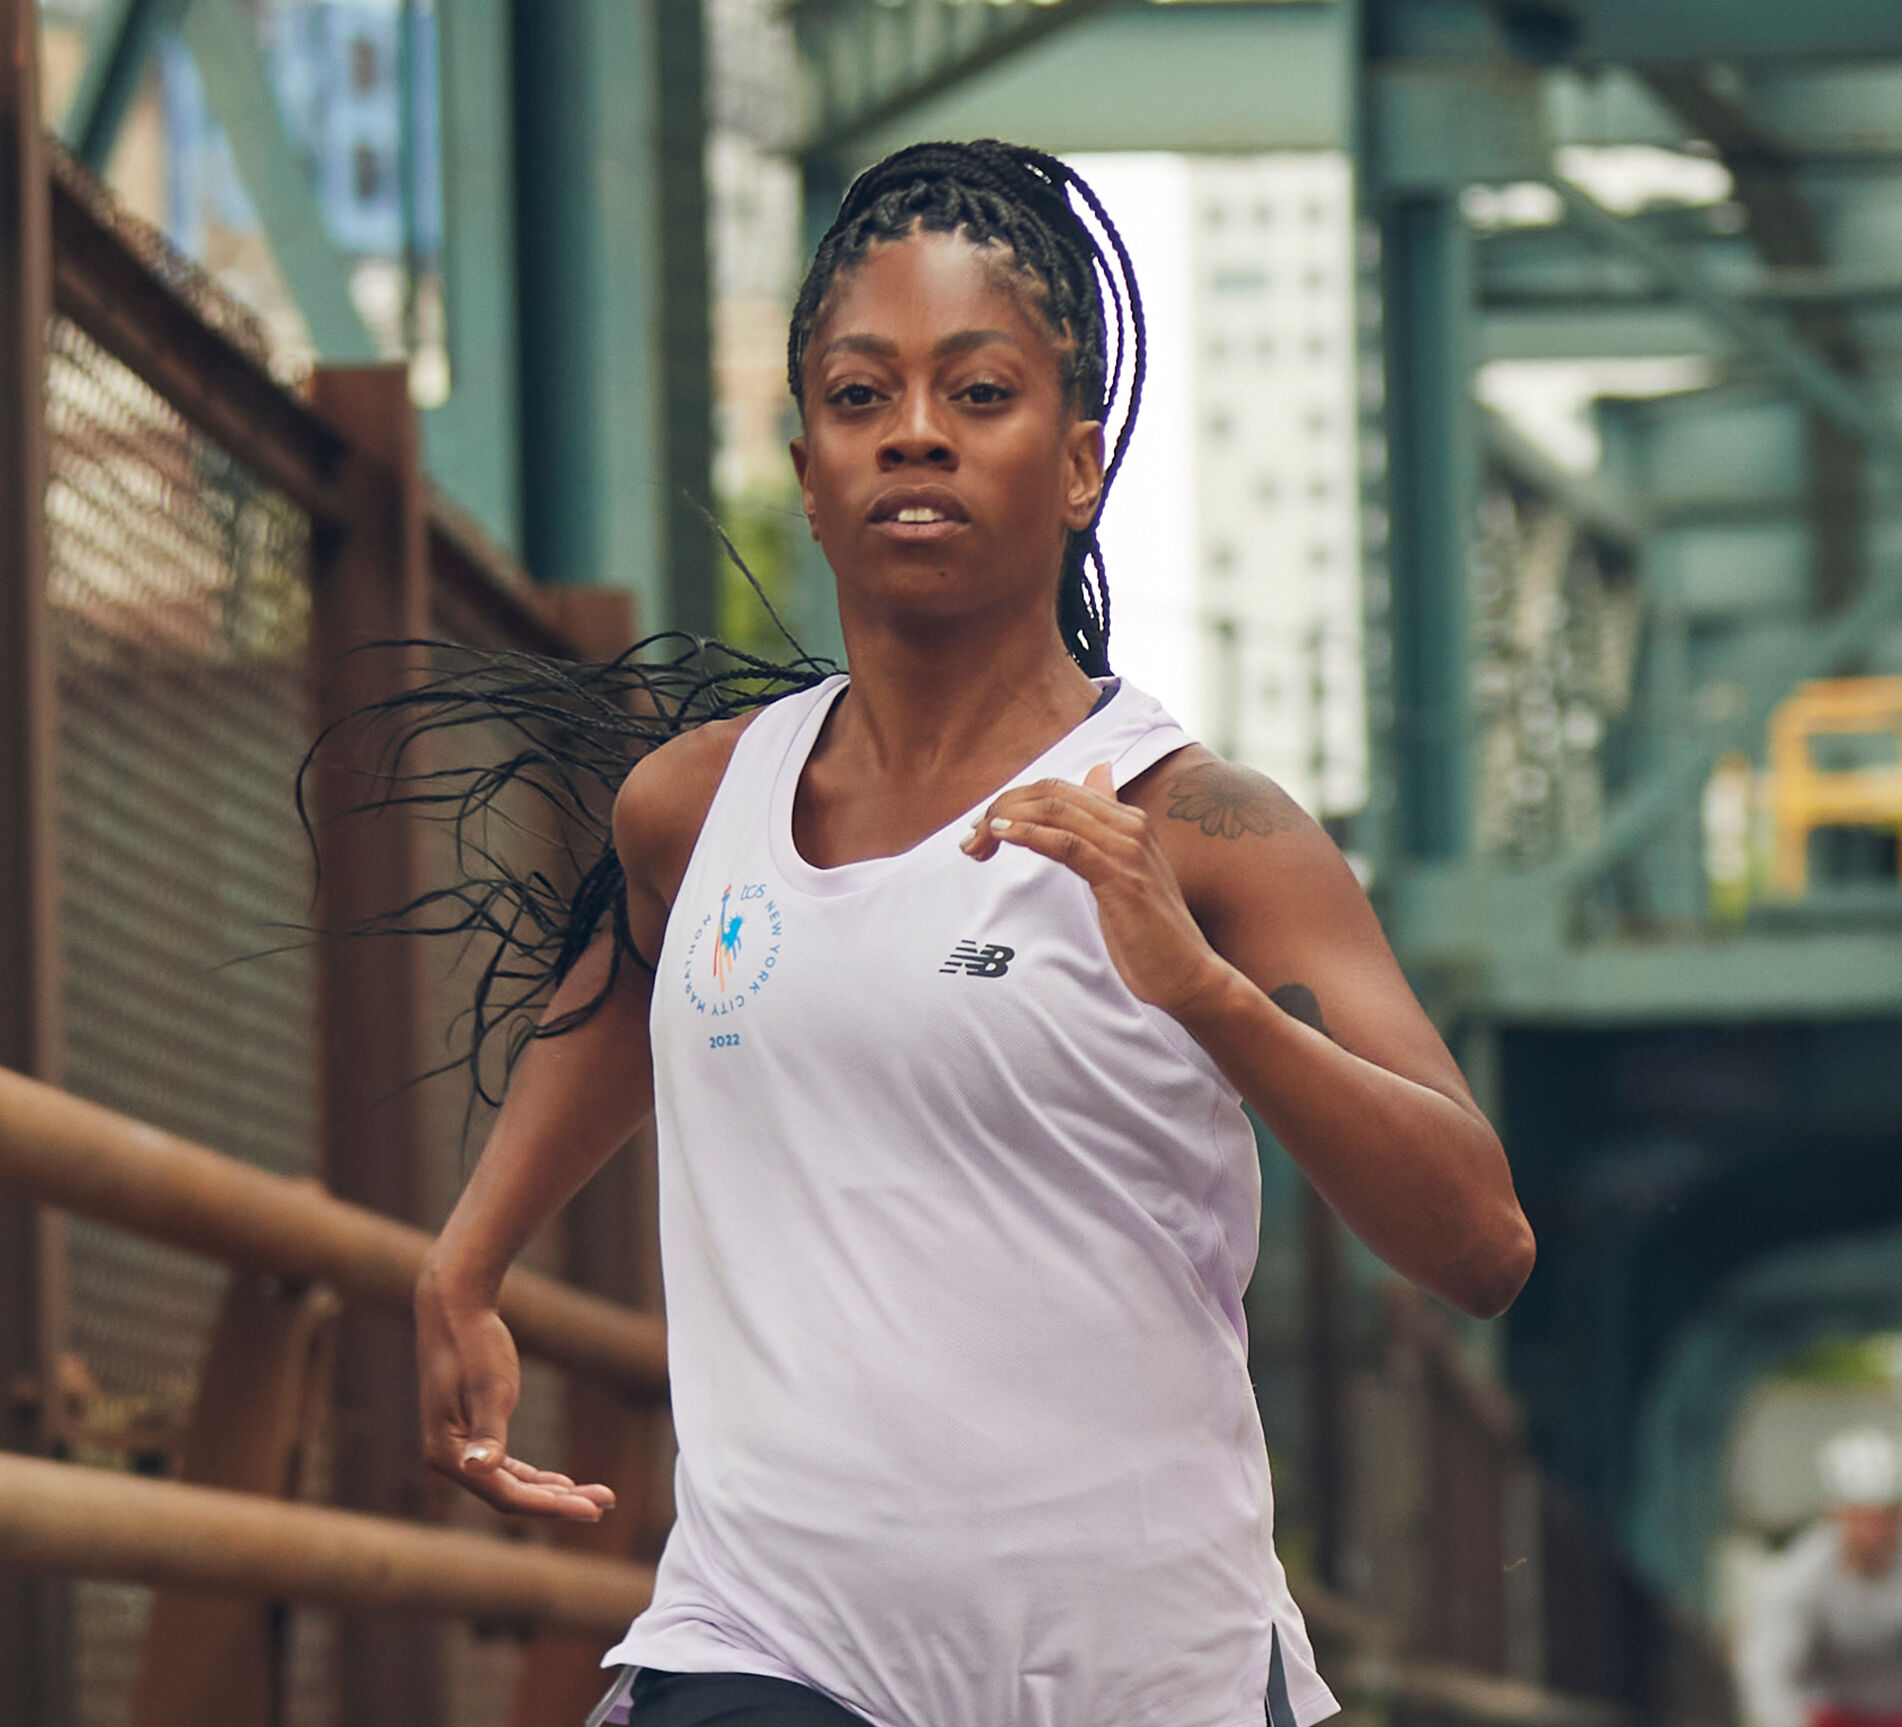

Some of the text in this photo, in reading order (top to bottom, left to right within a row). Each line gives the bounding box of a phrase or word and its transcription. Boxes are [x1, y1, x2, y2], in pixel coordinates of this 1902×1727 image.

[765, 900, 783, 936] NEW
[749, 944, 781, 995] YORK
[711, 995, 745, 1016] CITY
[709, 1034, 740, 1048] 2022
